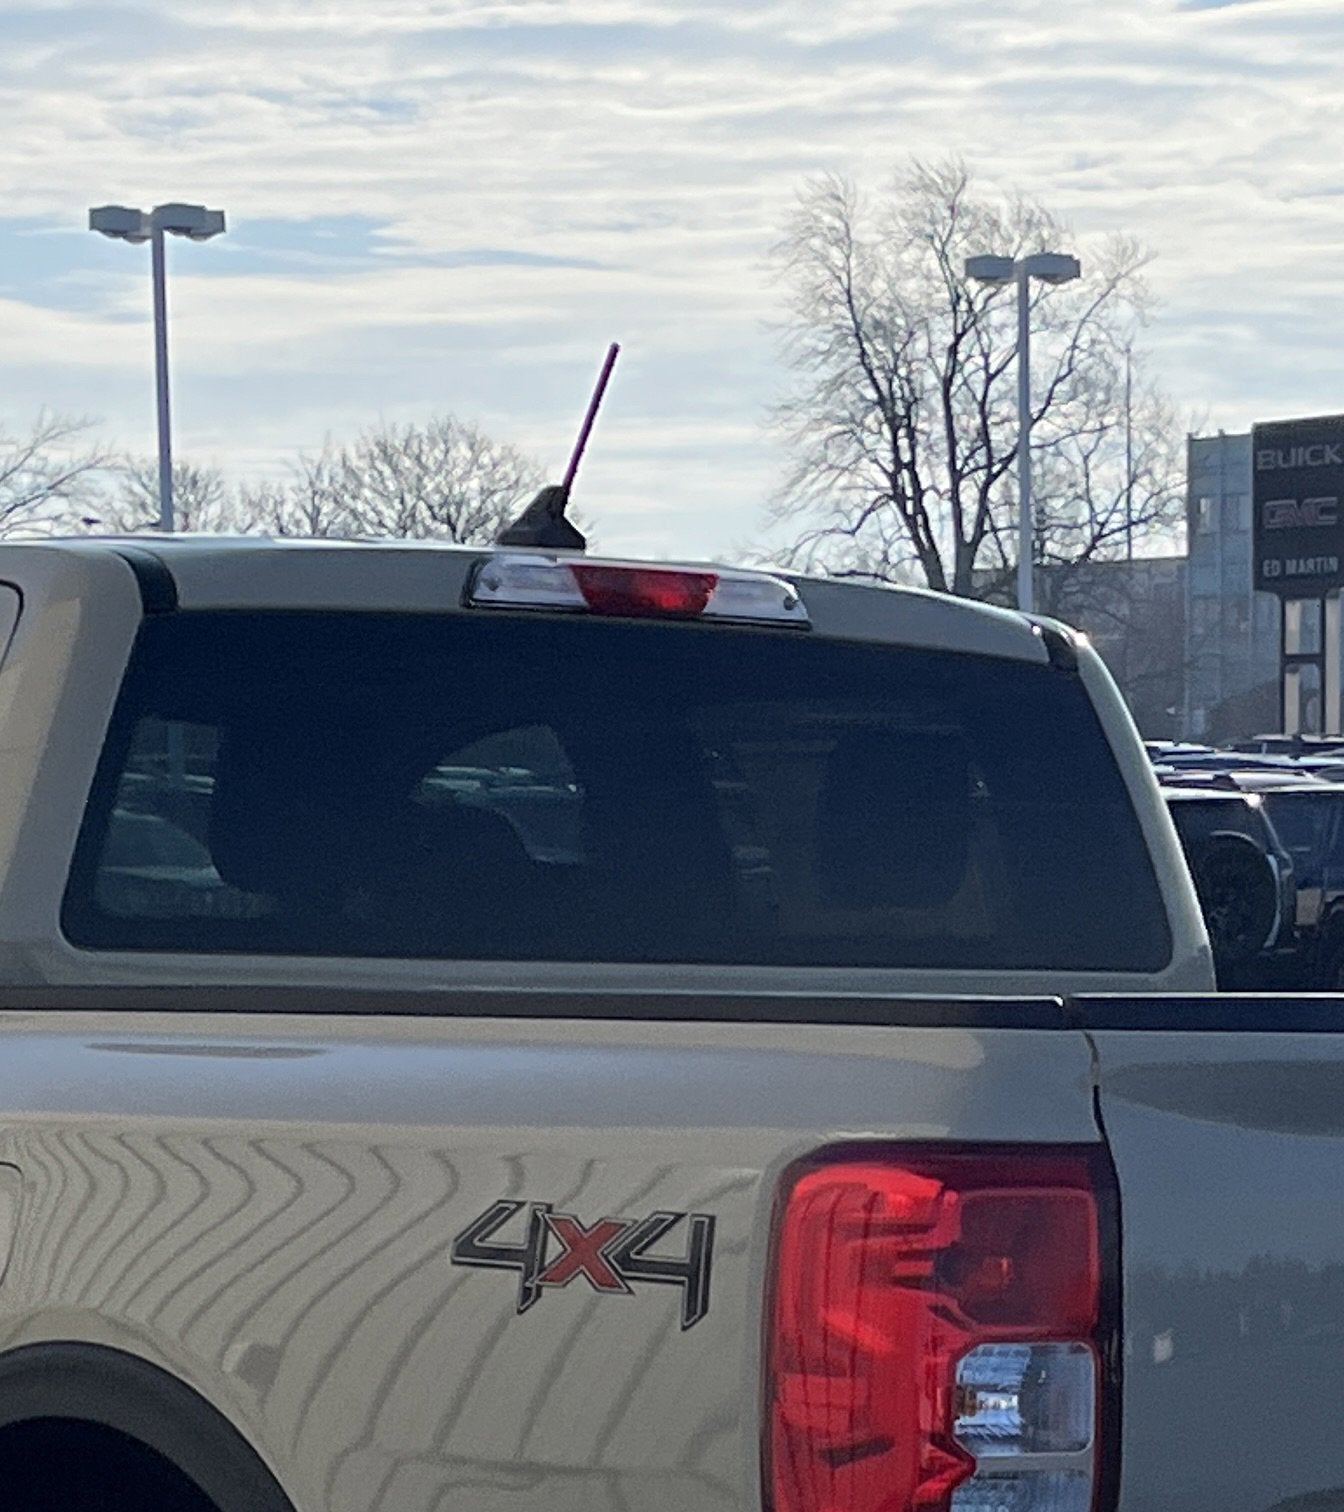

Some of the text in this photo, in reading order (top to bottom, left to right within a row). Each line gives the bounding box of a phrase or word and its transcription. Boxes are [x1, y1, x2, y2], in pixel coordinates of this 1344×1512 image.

[1256, 443, 1343, 471] BUICK
[1262, 496, 1338, 529] GMC
[1262, 556, 1338, 577] ED MARTIN
